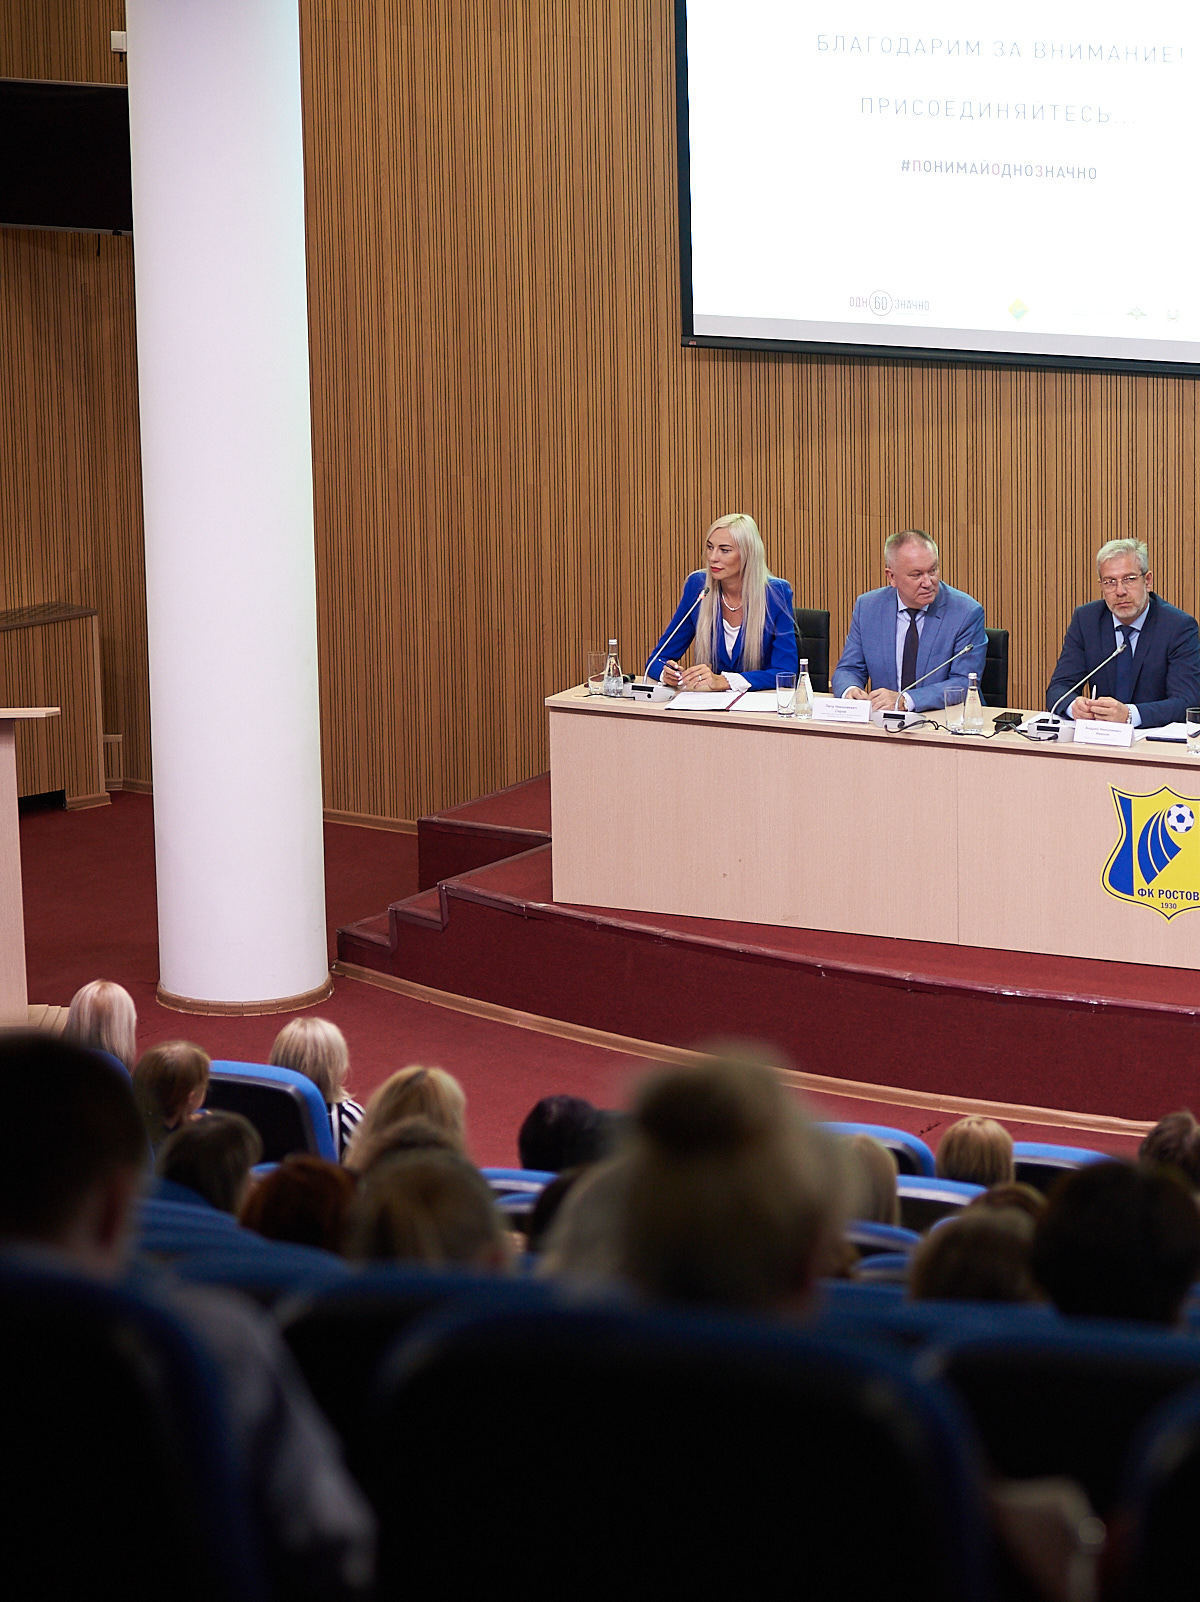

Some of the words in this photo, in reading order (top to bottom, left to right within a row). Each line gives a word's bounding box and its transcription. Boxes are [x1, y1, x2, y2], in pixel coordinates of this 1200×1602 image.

[816, 33, 981, 57] БЛАГОДАРИМ
[993, 40, 1023, 58] ЗА
[1033, 41, 1186, 64] ВНИМАНИЕ!
[900, 158, 1098, 181] #ПОНИМАЙОДНОЗНАЧНО
[1137, 888, 1154, 898] ФК
[1158, 889, 1200, 901] РОСТОВ
